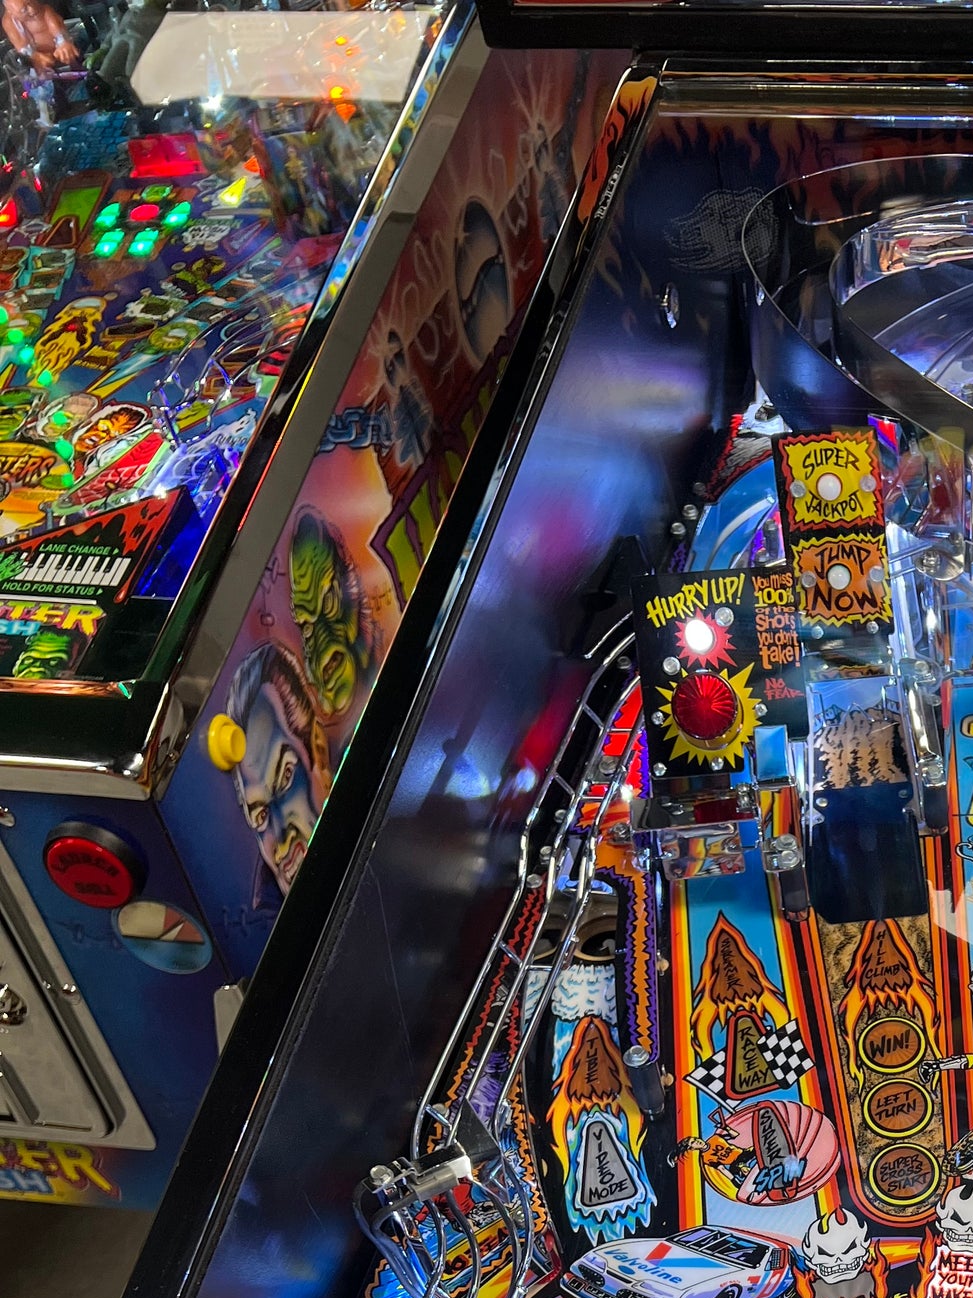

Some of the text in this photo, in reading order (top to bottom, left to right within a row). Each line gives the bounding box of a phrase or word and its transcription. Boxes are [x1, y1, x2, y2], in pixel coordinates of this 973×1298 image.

[802, 446, 860, 481] SUPER
[805, 489, 864, 519] JACKPOT
[39, 544, 112, 555] LANE CHANGE
[815, 545, 871, 580] JUMP
[2, 582, 96, 596] HOLD FOR STATUS
[646, 573, 745, 628] HURRY UP!
[812, 580, 878, 612] NOW
[759, 645, 801, 670] take!
[865, 964, 900, 979] CLIMB
[738, 1026, 756, 1073] RACE
[869, 1028, 911, 1059] WIN!
[584, 1037, 600, 1086] TUBE
[738, 1067, 769, 1089] WAY
[876, 1089, 913, 1110] LEFT
[876, 1099, 917, 1121] TURN
[760, 1109, 785, 1165] SUPER
[593, 1129, 614, 1184] VIDEO
[880, 1154, 921, 1174] SUPER
[881, 1164, 922, 1182] CROSS
[887, 1172, 930, 1193] START
[588, 1181, 630, 1201] MODE
[604, 1248, 684, 1286] Valvoline
